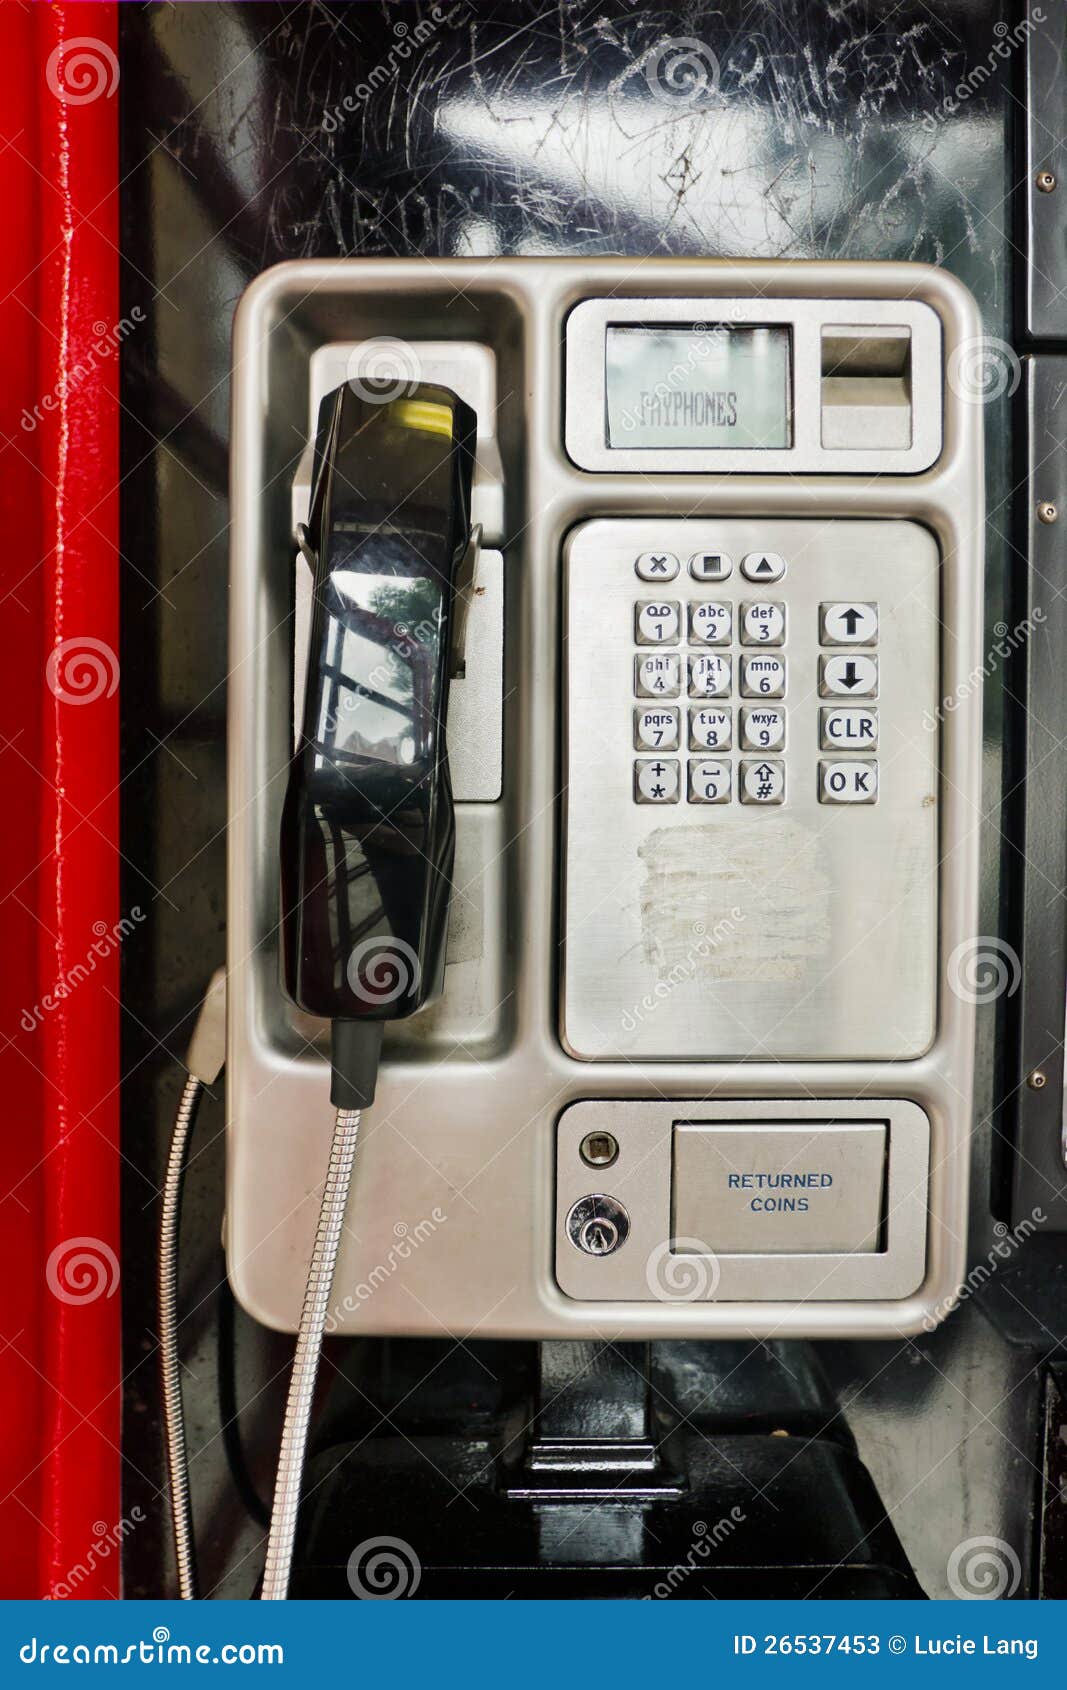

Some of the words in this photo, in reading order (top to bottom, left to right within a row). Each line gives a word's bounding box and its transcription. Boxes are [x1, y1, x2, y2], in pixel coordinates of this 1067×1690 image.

[640, 391, 737, 426] PAYPHONES
[698, 606, 725, 618] abc
[751, 606, 774, 619] def
[654, 624, 663, 640] 1
[706, 624, 717, 640] 2
[759, 624, 770, 640] 3
[645, 659, 670, 673] ghi
[699, 659, 722, 674] jkl
[751, 661, 779, 672] mno
[653, 676, 665, 692] 4
[705, 677, 717, 693] 5
[759, 677, 771, 693] 6
[644, 714, 673, 727] pqrs
[699, 712, 726, 725] tuv
[751, 713, 778, 726] wxyz
[828, 717, 874, 738] CLR
[652, 730, 664, 746] 7
[706, 730, 718, 746] 8
[759, 730, 770, 746] 9
[829, 771, 870, 792] OK
[705, 783, 718, 799] 0
[728, 1173, 833, 1189] RETURNED
[750, 1197, 809, 1212] COINS
